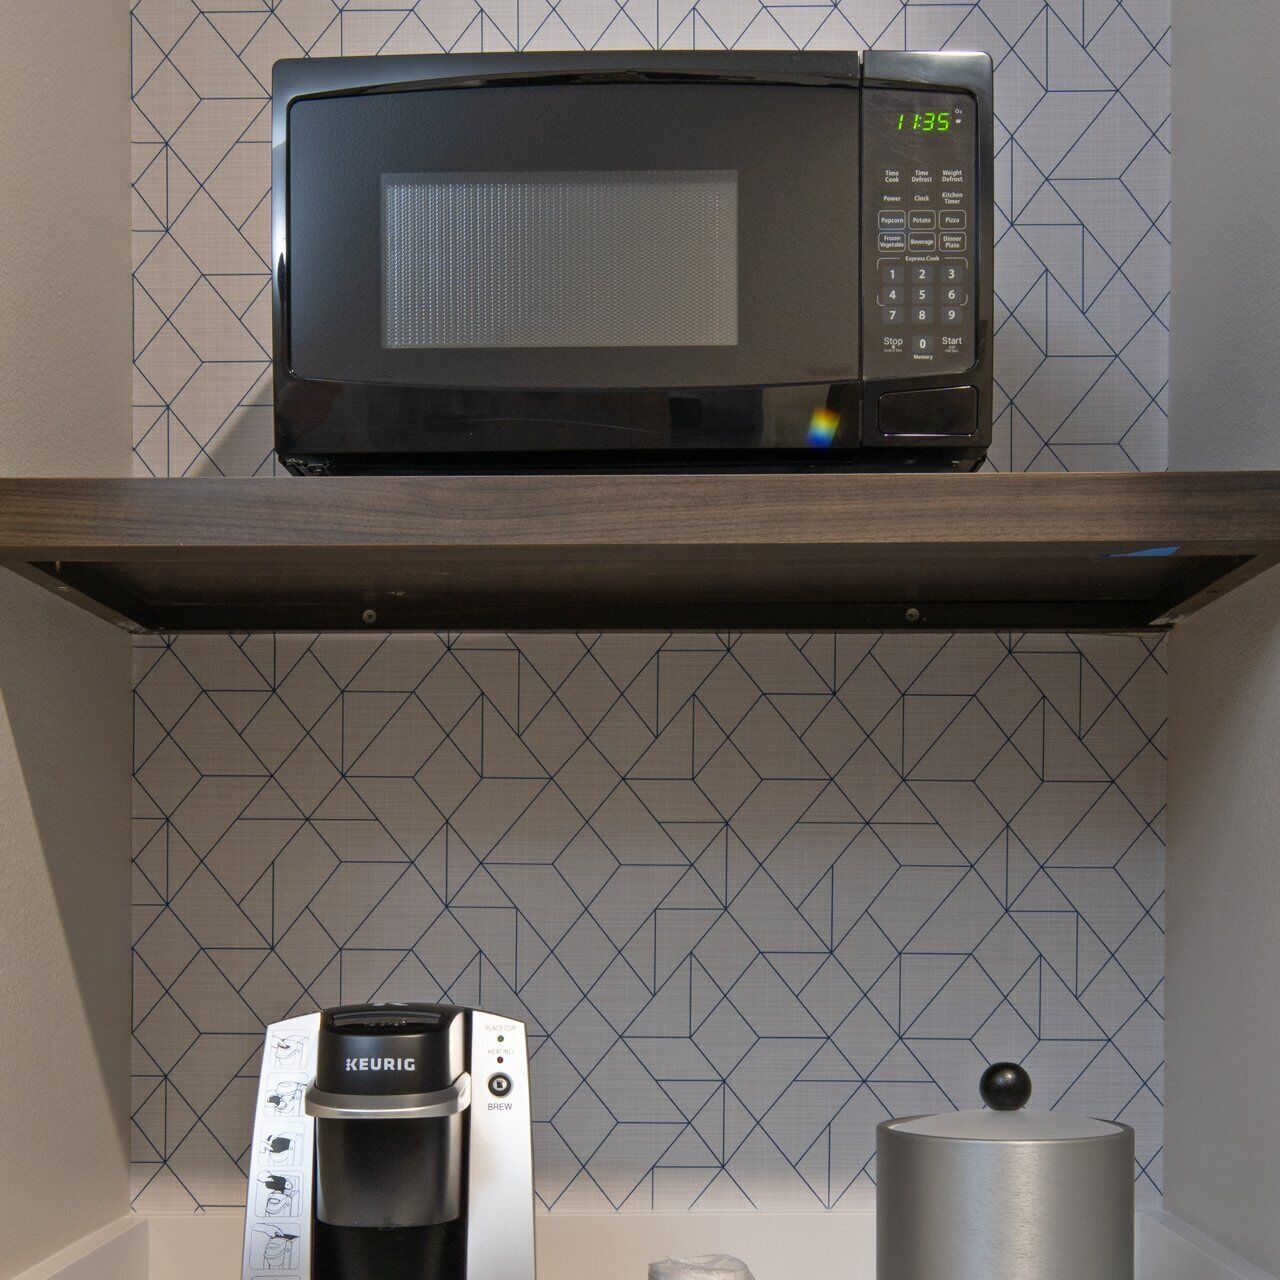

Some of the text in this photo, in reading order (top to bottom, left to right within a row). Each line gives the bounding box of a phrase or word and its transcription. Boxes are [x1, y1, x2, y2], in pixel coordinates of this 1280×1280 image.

[898, 112, 950, 131] 11:35
[889, 269, 896, 279] 1
[918, 269, 926, 279] 2
[948, 269, 956, 279] 3
[889, 290, 896, 300] 4
[918, 290, 926, 300] 5
[948, 290, 956, 300] 6
[889, 310, 896, 320] 7
[918, 310, 926, 320] 8
[948, 310, 956, 320] 9
[883, 336, 904, 347] Stop
[941, 336, 962, 345] Start
[345, 1057, 416, 1072] KEURIG
[487, 1102, 513, 1111] BREW
